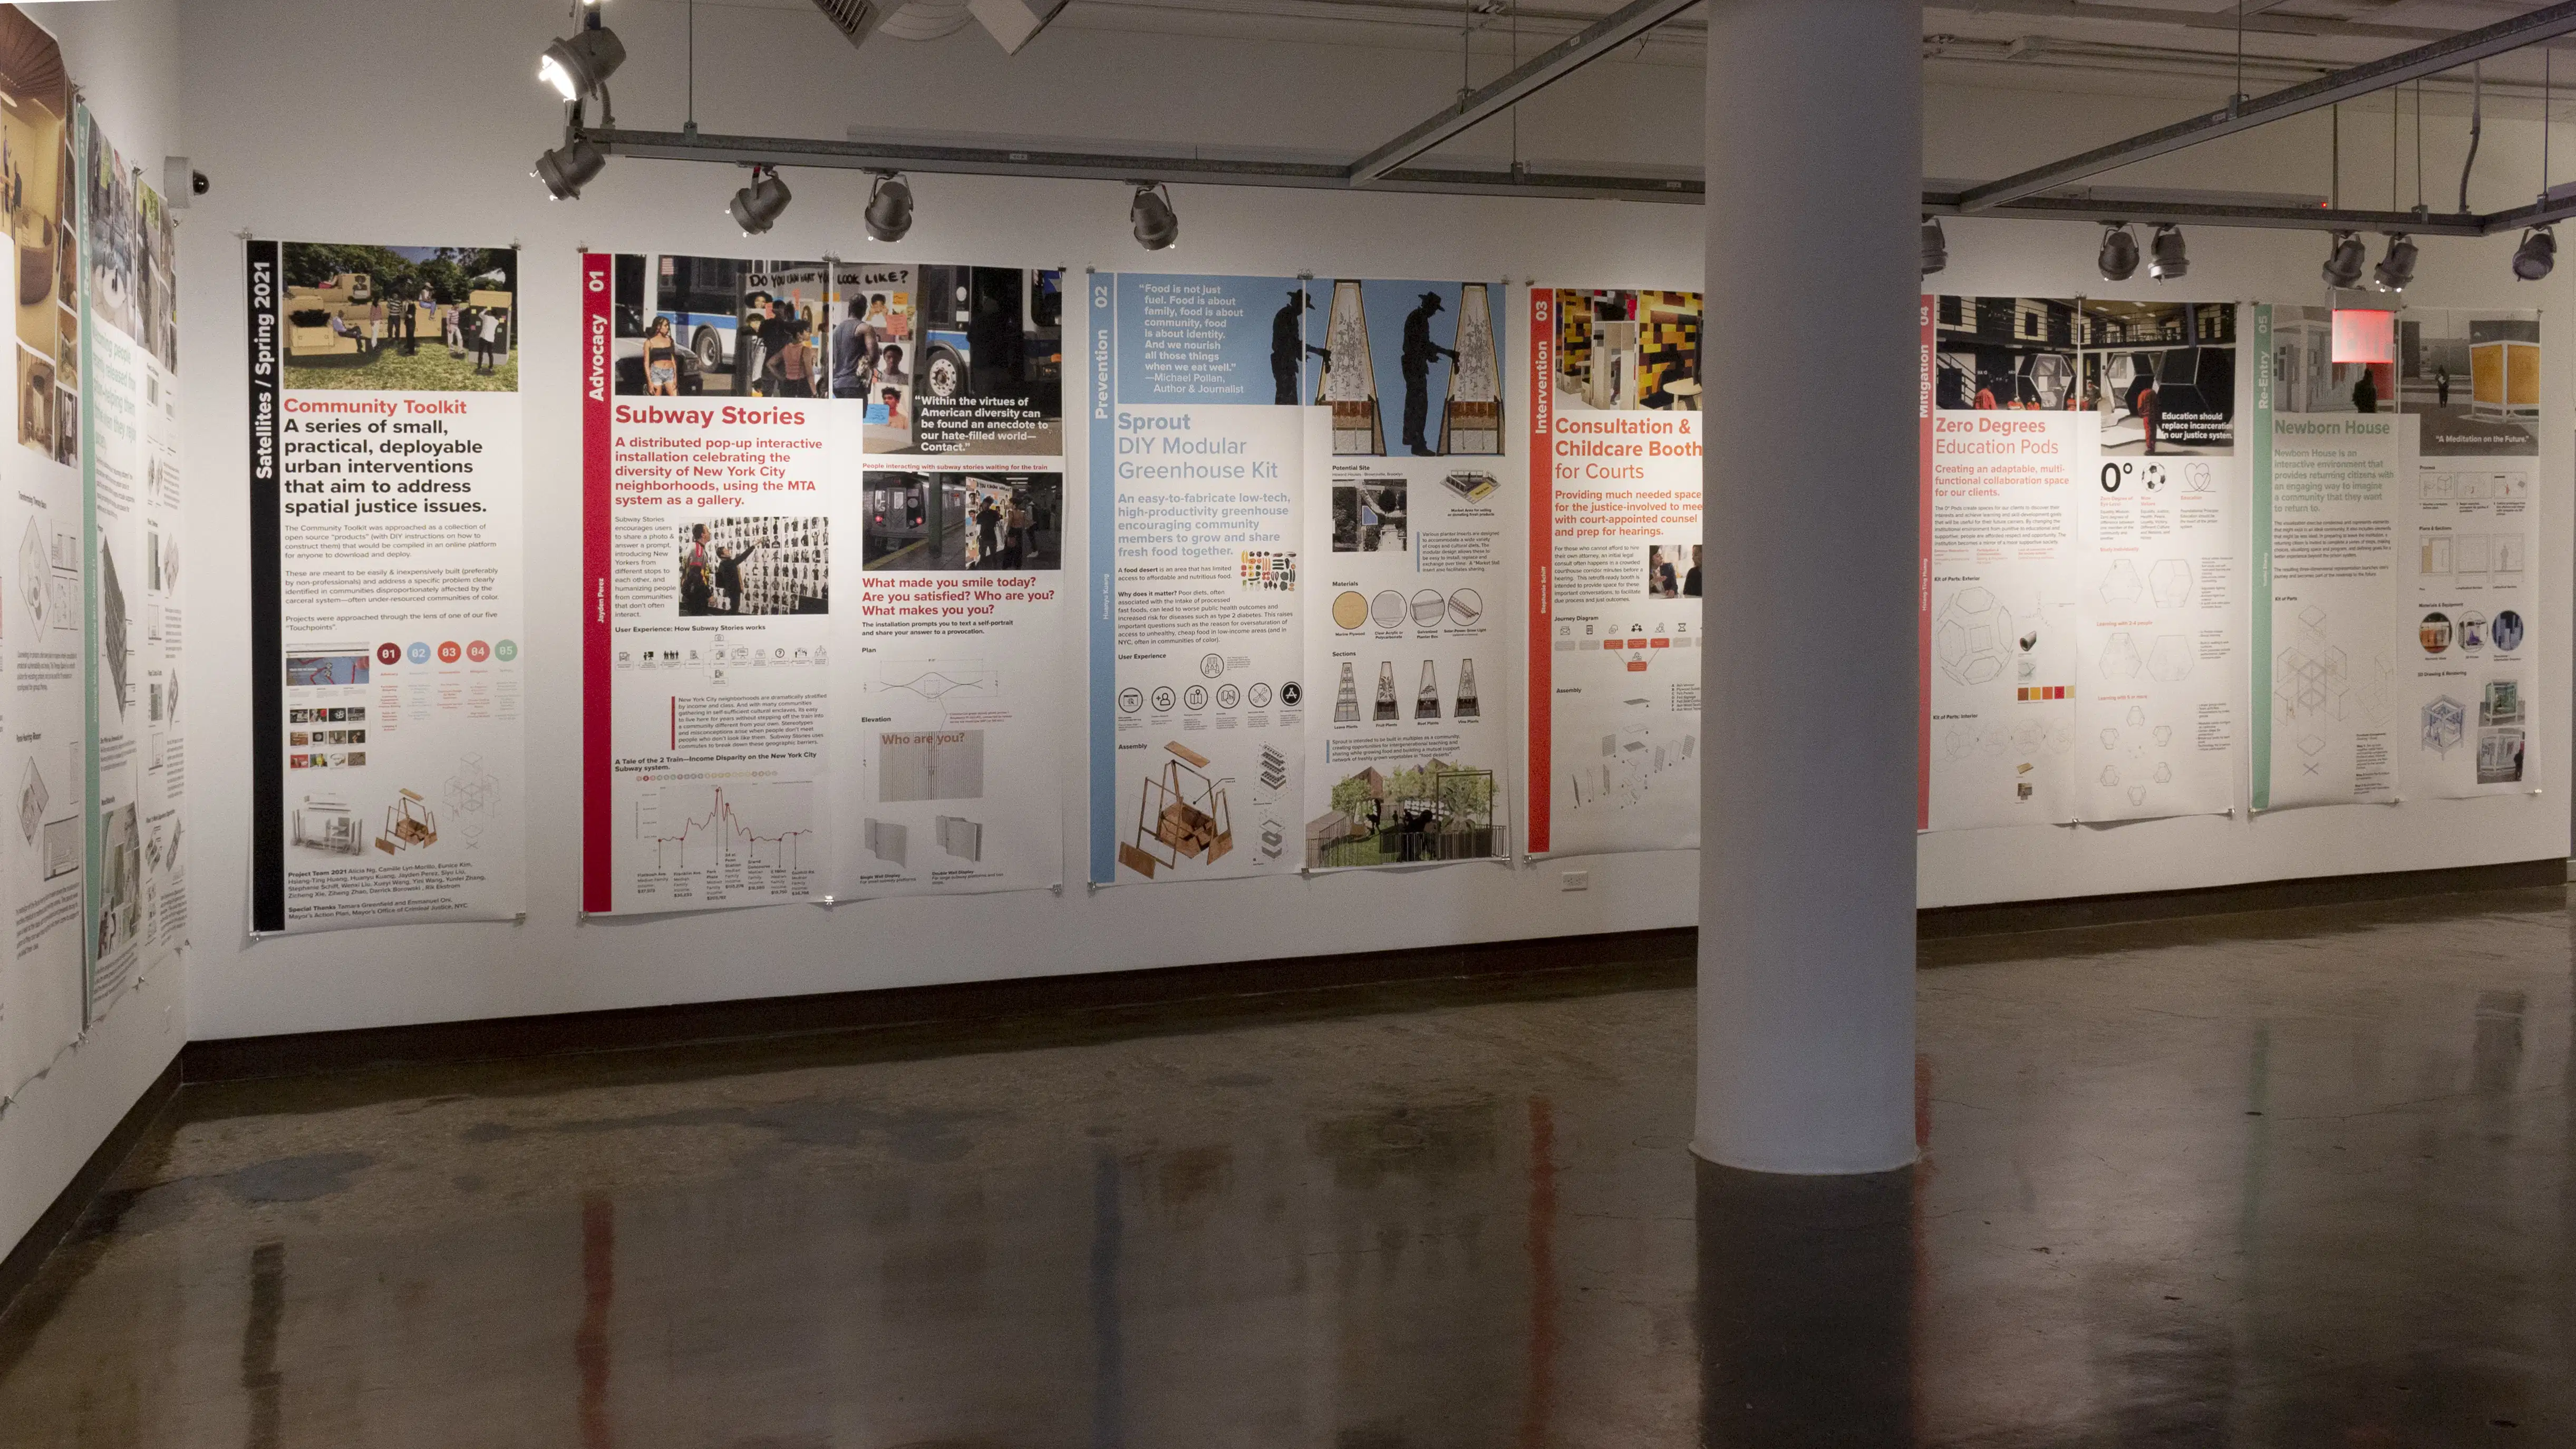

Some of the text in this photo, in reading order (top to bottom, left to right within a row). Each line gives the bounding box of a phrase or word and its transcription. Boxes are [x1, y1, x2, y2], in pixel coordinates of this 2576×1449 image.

[255, 263, 269, 307] 2021
[254, 315, 274, 374] Spring
[589, 272, 607, 401] Advocacy 01
[1095, 286, 1108, 420] Prevention 02
[1535, 300, 1548, 434] Intervention 03
[2258, 315, 2270, 410] Re-Entry 05
[284, 398, 466, 416] Community Toolkit
[616, 405, 805, 428] Subway Stories
[1118, 413, 1190, 434] Sprout
[284, 419, 447, 435] A series of small,
[1555, 417, 1691, 434] Consultation &
[1936, 417, 2046, 436] Zero Degrees
[2162, 422, 2188, 431] replace
[2274, 420, 2390, 435] Newborn House
[255, 392, 272, 478] Satellites
[2183, 432, 2207, 440] justice
[285, 439, 482, 456] practical, deployable
[615, 437, 821, 450] A distributed pop-up interactive
[1119, 437, 1246, 454] DIY Modular
[1555, 440, 1702, 456] Childcare Booth
[1936, 439, 2060, 455] Education Pods
[616, 451, 790, 464] installation celebrating the
[286, 459, 472, 473] urban interventions
[615, 465, 785, 479] diversity of New York City
[1118, 461, 1277, 479] Greenhouse Kit
[1555, 463, 1643, 479] for Courts
[285, 479, 471, 493] that aim to address
[616, 480, 815, 493] neighborhoods, using the MTA
[615, 495, 662, 507] system
[698, 495, 743, 507] gallery.
[1118, 493, 1290, 505] An easy-to-fabricate low-tech,
[1555, 490, 1701, 501] Providing much needed space
[285, 499, 486, 517] spatial justice issues.
[1118, 507, 1289, 519] high-productivity greenhouse
[1118, 519, 1259, 531] encouraging community
[1118, 534, 1173, 543] members
[1192, 536, 1220, 544] grow
[1225, 533, 1245, 541] and
[1118, 546, 1235, 557] fresh food together.
[862, 578, 895, 588] What
[899, 578, 933, 588] made
[962, 577, 993, 587] smile
[997, 577, 1036, 588] today?
[862, 592, 884, 602] Are
[889, 595, 909, 603] you
[915, 591, 970, 600] satisfied?
[974, 591, 1001, 600] Who
[1028, 590, 1054, 602] you?
[863, 605, 994, 617] What makes you you?
